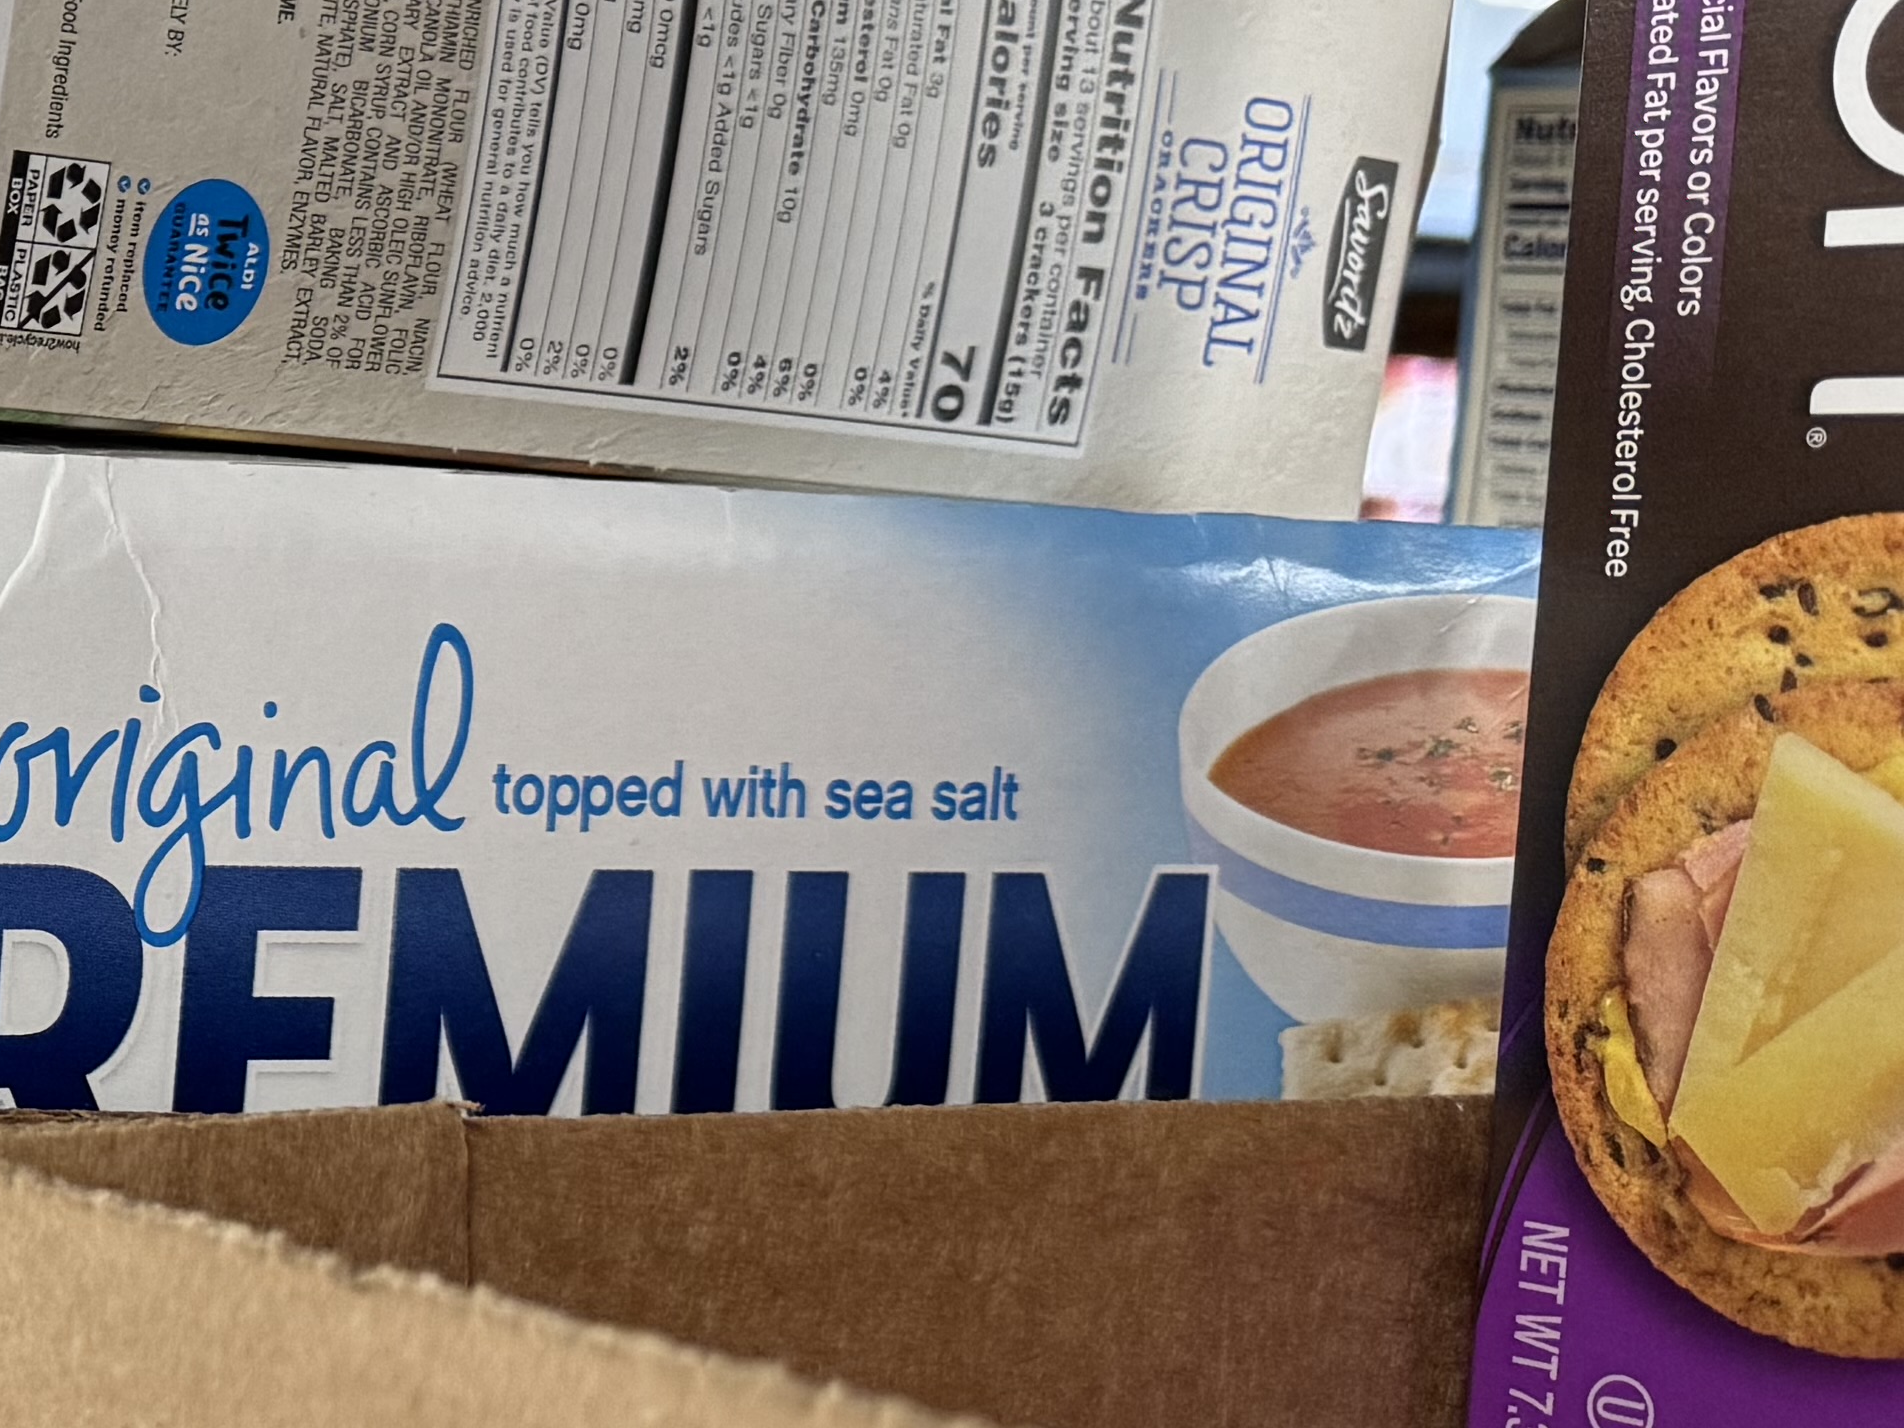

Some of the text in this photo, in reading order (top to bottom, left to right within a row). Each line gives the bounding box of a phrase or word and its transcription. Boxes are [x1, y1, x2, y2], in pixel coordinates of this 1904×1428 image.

[164, 28, 185, 57] BY:
[647, 7, 675, 69] 0mcg
[820, 35, 847, 107] 135mg
[931, 22, 952, 65] Fat
[1019, 43, 1033, 77] per
[45, 39, 77, 140] Ingredients
[924, 71, 944, 99] 3g
[1078, 65, 1100, 95] 13
[1642, 71, 1677, 123] Fat
[1689, 48, 1729, 166] Flavors
[446, 87, 471, 144] FLOUR
[1007, 81, 1029, 151] serving
[1046, 101, 1070, 163] size
[1059, 101, 1091, 207] servings
[1634, 128, 1665, 182] per
[1686, 170, 1712, 206] or
[6, 176, 22, 215] BOX
[433, 160, 459, 225] (WHEAT
[1037, 200, 1056, 218] 3
[1134, 129, 1174, 301] CRACKERS
[1157, 137, 1230, 312] CRISP
[4, 167, 42, 324] PAPER PLASTIC
[93, 198, 126, 332] money refunded
[115, 201, 147, 313] item replaced
[153, 201, 188, 316] GUARANTEE
[175, 213, 210, 312] as Nice
[204, 215, 251, 312] Twice
[240, 241, 260, 290] ALDI
[1053, 213, 1073, 257] per
[1200, 95, 1296, 368] ORIGINAL
[1331, 168, 1390, 342] Savoritz
[1619, 187, 1660, 312] serving,
[1676, 211, 1716, 317] Colors
[416, 241, 446, 300] FLOUR,
[921, 280, 936, 300] %
[1013, 225, 1048, 347] crackers
[400, 316, 431, 376] NIACIN,
[909, 303, 932, 352] Daily
[1028, 261, 1063, 380] container
[1046, 264, 1106, 427] Facts
[596, 345, 619, 382] 0%
[771, 356, 794, 398] 6%
[871, 368, 893, 410] 4%
[930, 344, 977, 423] 70
[993, 354, 1028, 424] (15g)
[1611, 318, 1655, 501] Cholesterol
[1604, 509, 1640, 578] Free
[491, 759, 685, 833] topped
[701, 761, 807, 819] with
[824, 778, 914, 821] sea
[930, 765, 1020, 822] salt
[1518, 1220, 1570, 1306] NET
[1511, 1314, 1563, 1381] WT
